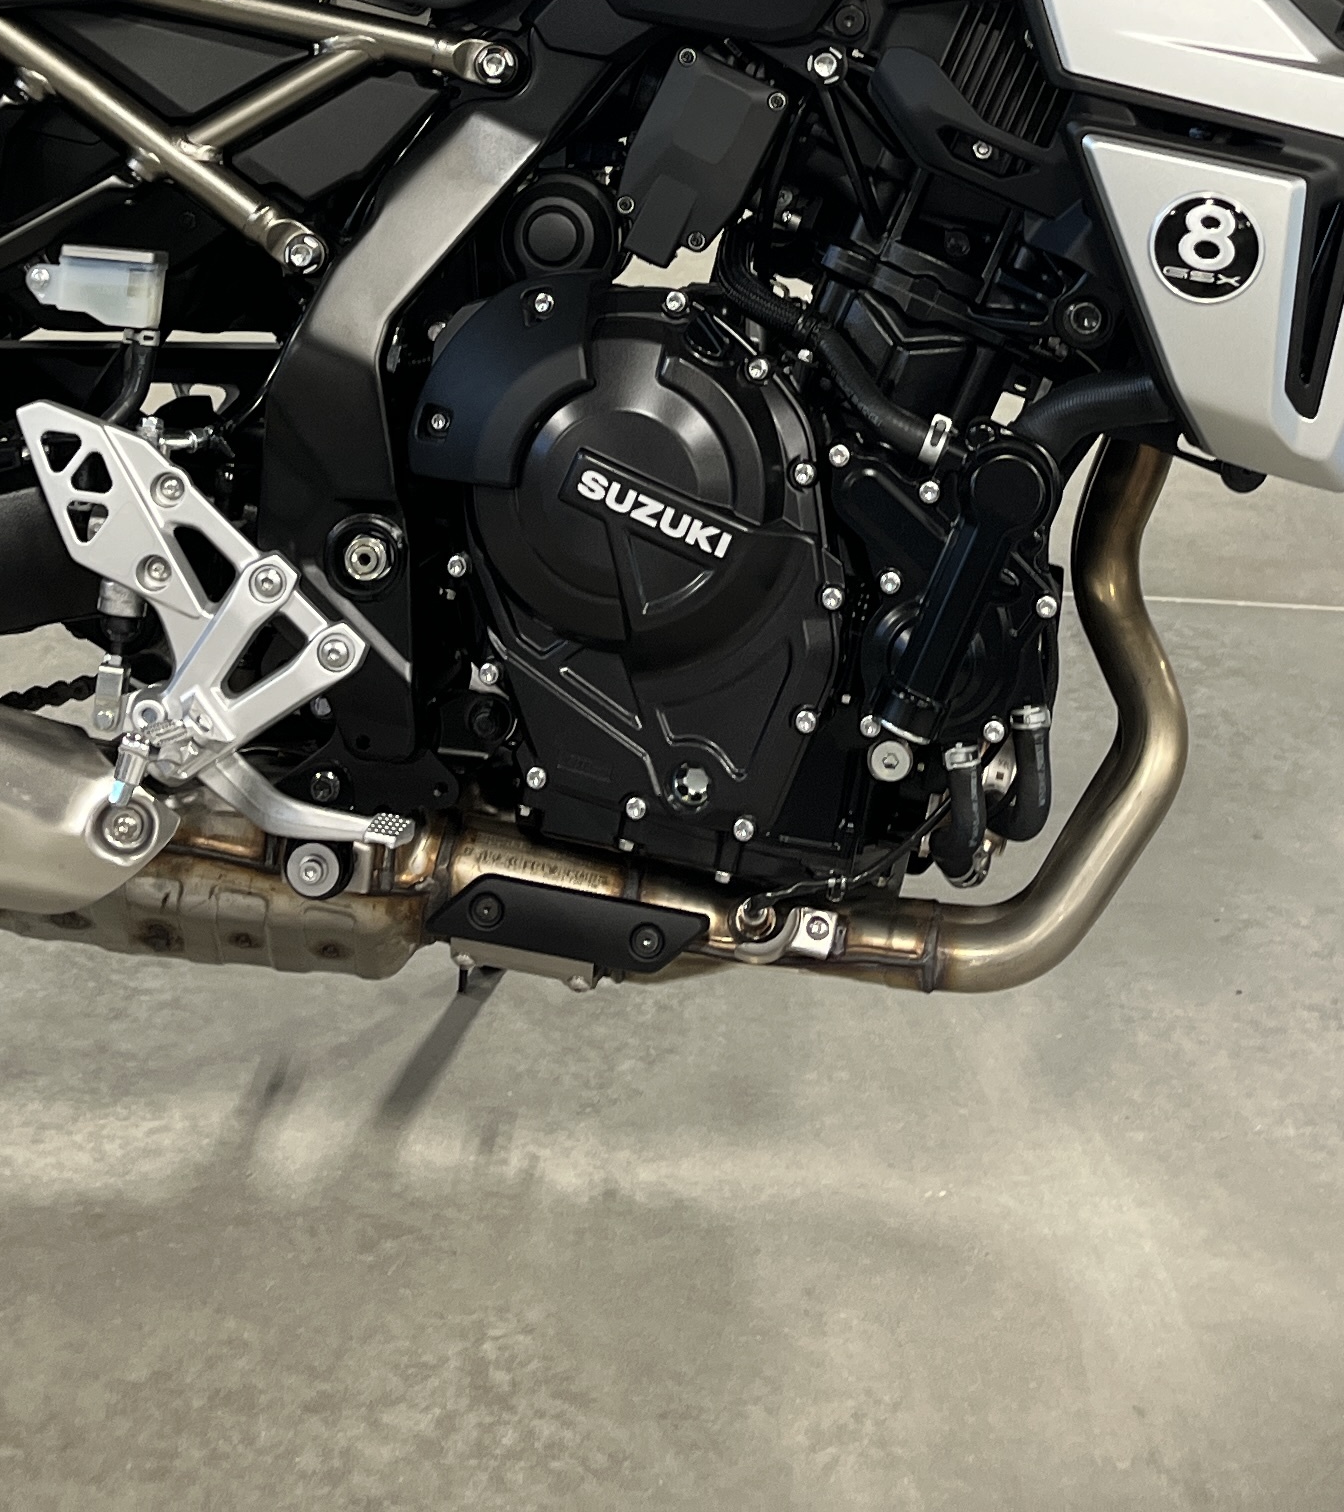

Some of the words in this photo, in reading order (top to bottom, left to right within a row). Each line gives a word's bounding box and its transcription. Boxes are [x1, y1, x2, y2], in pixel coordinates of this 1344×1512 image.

[1178, 203, 1236, 272] 8
[1163, 266, 1241, 287] GSX
[576, 468, 734, 560] SUZUKI
